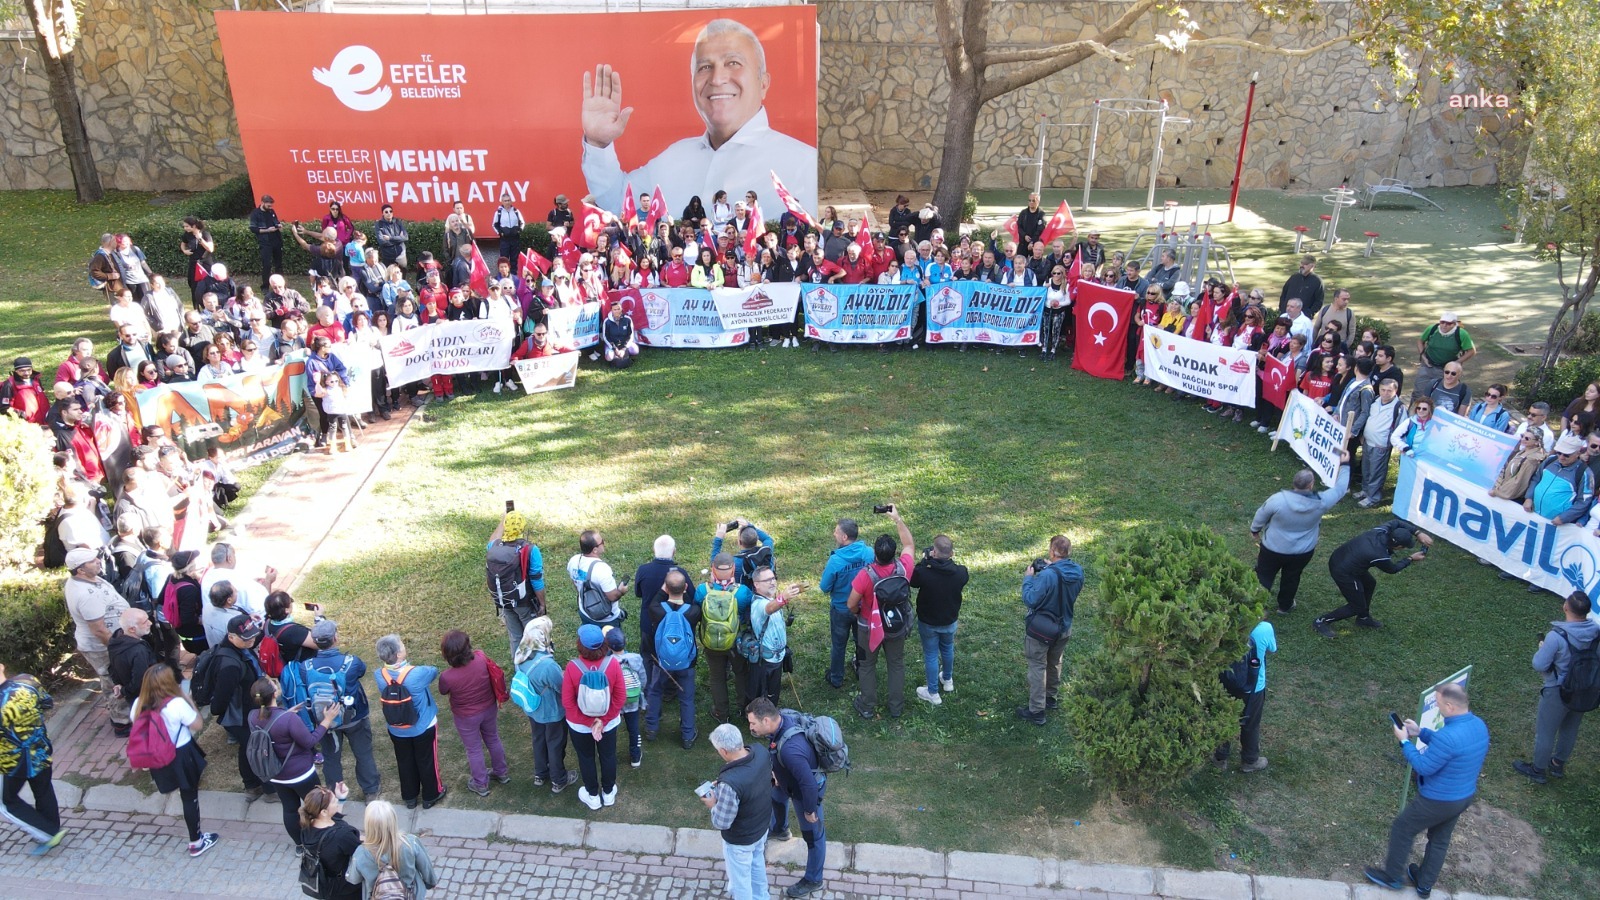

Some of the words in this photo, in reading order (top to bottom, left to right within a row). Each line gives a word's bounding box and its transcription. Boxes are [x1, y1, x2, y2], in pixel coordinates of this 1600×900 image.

[421, 54, 434, 62] T.C.
[389, 64, 467, 84] EFELER
[401, 85, 461, 98] BELEDİYESİ
[290, 149, 315, 163] T.C.
[317, 149, 371, 163] EFELER
[380, 149, 489, 172] MEHMET
[307, 167, 374, 183] BELEDİYE
[316, 190, 377, 206] BAŞKANI
[385, 176, 461, 203] FATİH
[467, 181, 530, 203] ATAY
[843, 293, 912, 311] AYYILDIZ
[968, 291, 1043, 314] AYYILDIZ
[430, 336, 467, 348] AYDIN
[436, 346, 495, 360] SPORLARI
[1173, 354, 1219, 376] AYDAK
[1159, 364, 1180, 378] AYDIN
[1181, 372, 1216, 388] DAĞCILIK
[1218, 382, 1239, 393] SPOR
[1182, 381, 1213, 396] KULÜBÜ
[246, 426, 302, 452] KARAVAN
[1314, 413, 1344, 446] EFELER
[1309, 428, 1334, 453] KENT
